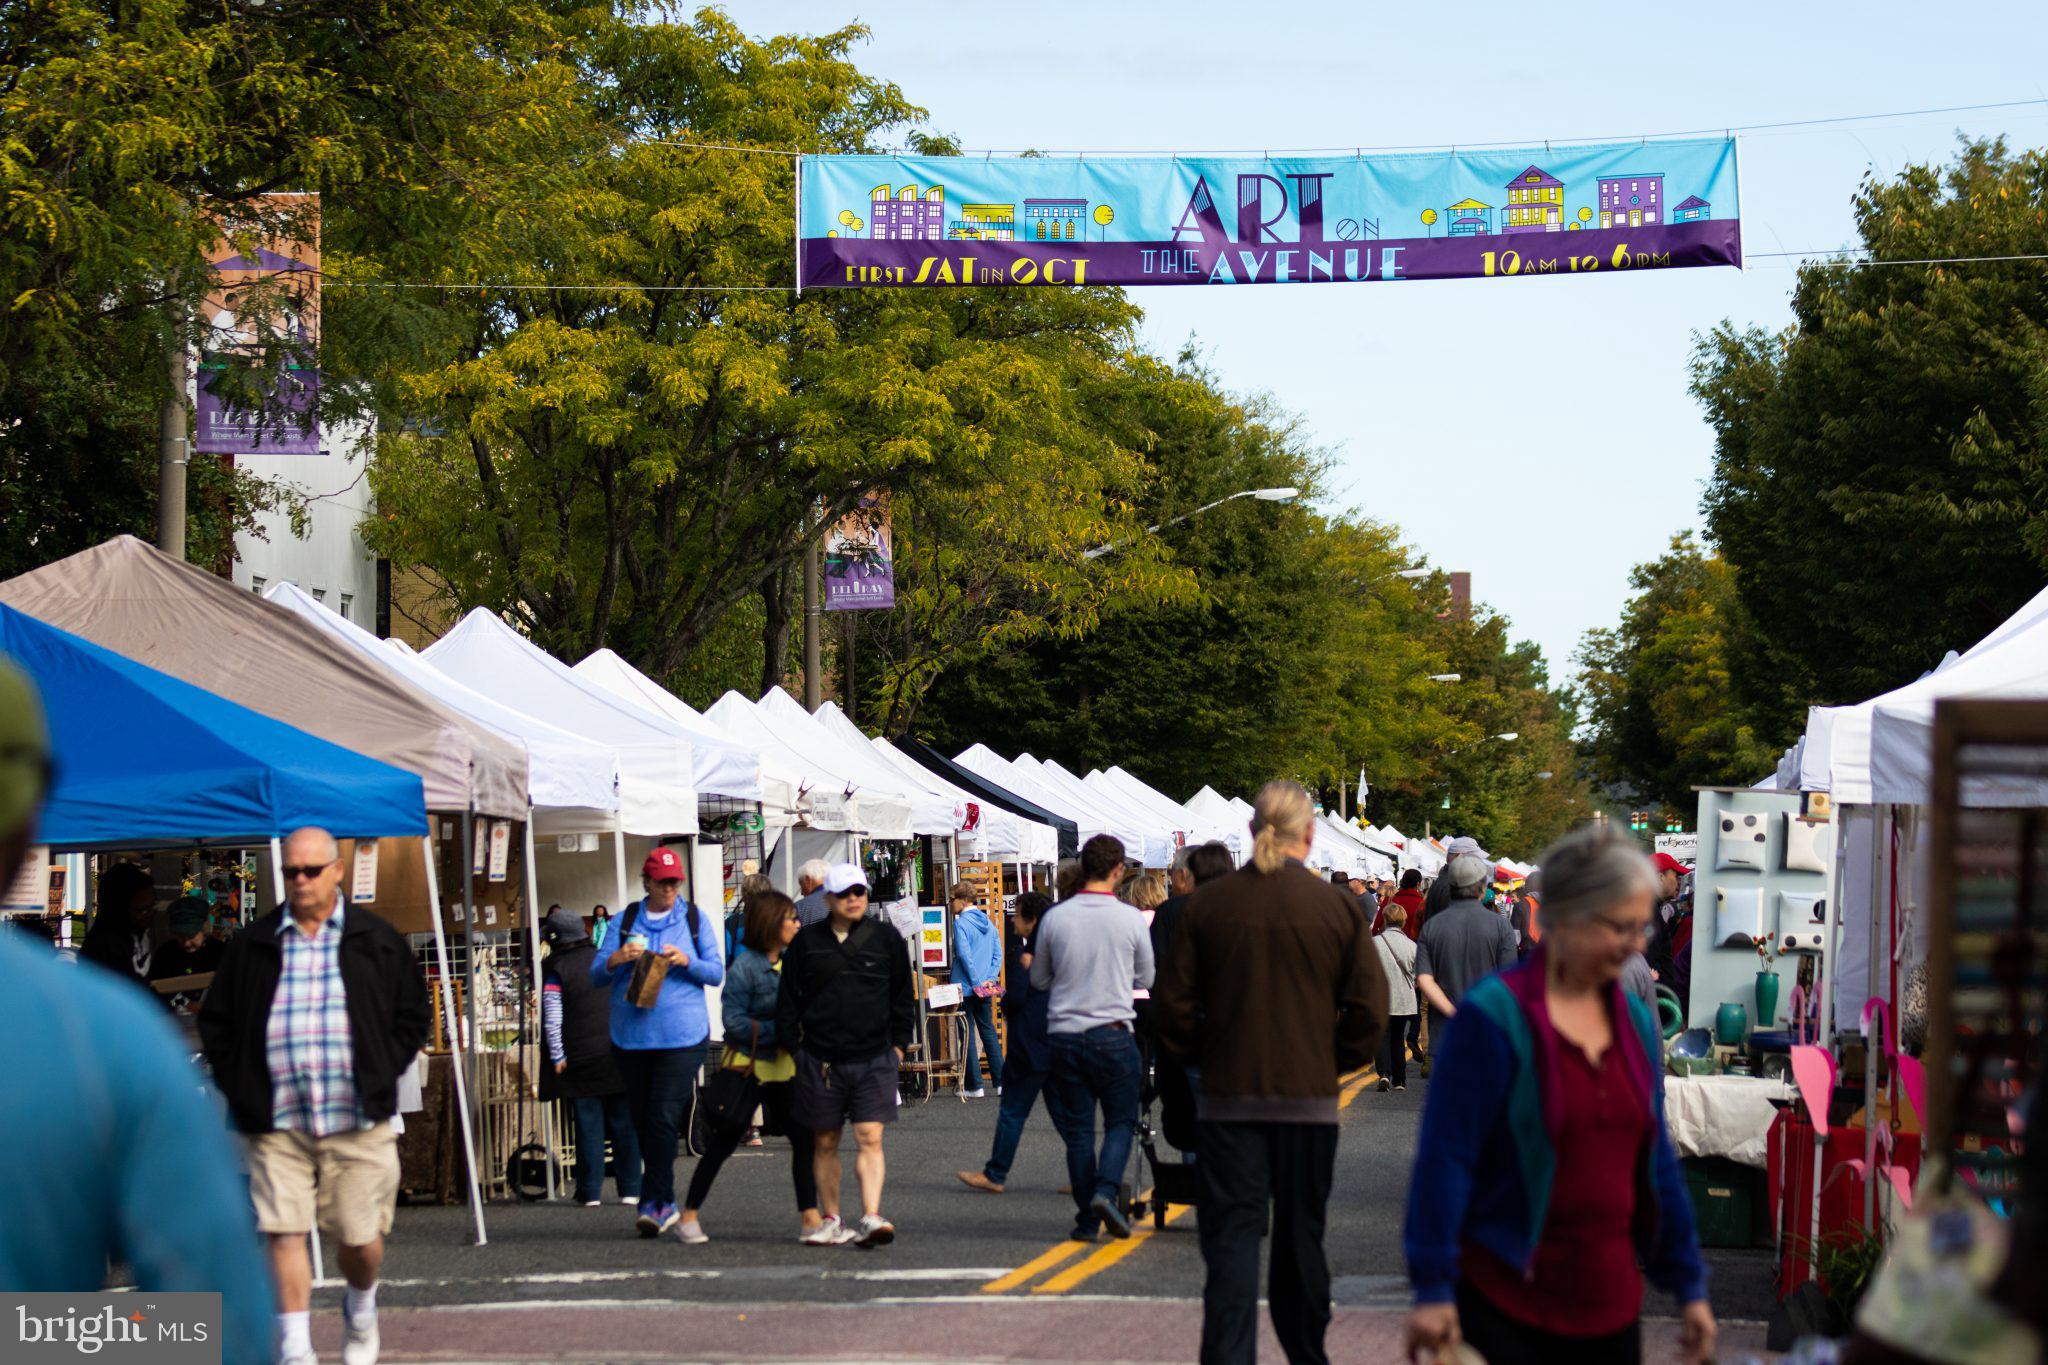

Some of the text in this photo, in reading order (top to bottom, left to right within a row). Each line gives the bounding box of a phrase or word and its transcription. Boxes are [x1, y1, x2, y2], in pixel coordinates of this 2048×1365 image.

[1172, 173, 1380, 244] ART ON
[846, 257, 1090, 285] FIRST SAT IN OCT
[1140, 247, 1407, 285] THE AVENUE
[1568, 255, 1599, 272] TO
[832, 584, 884, 594] DEL RAY
